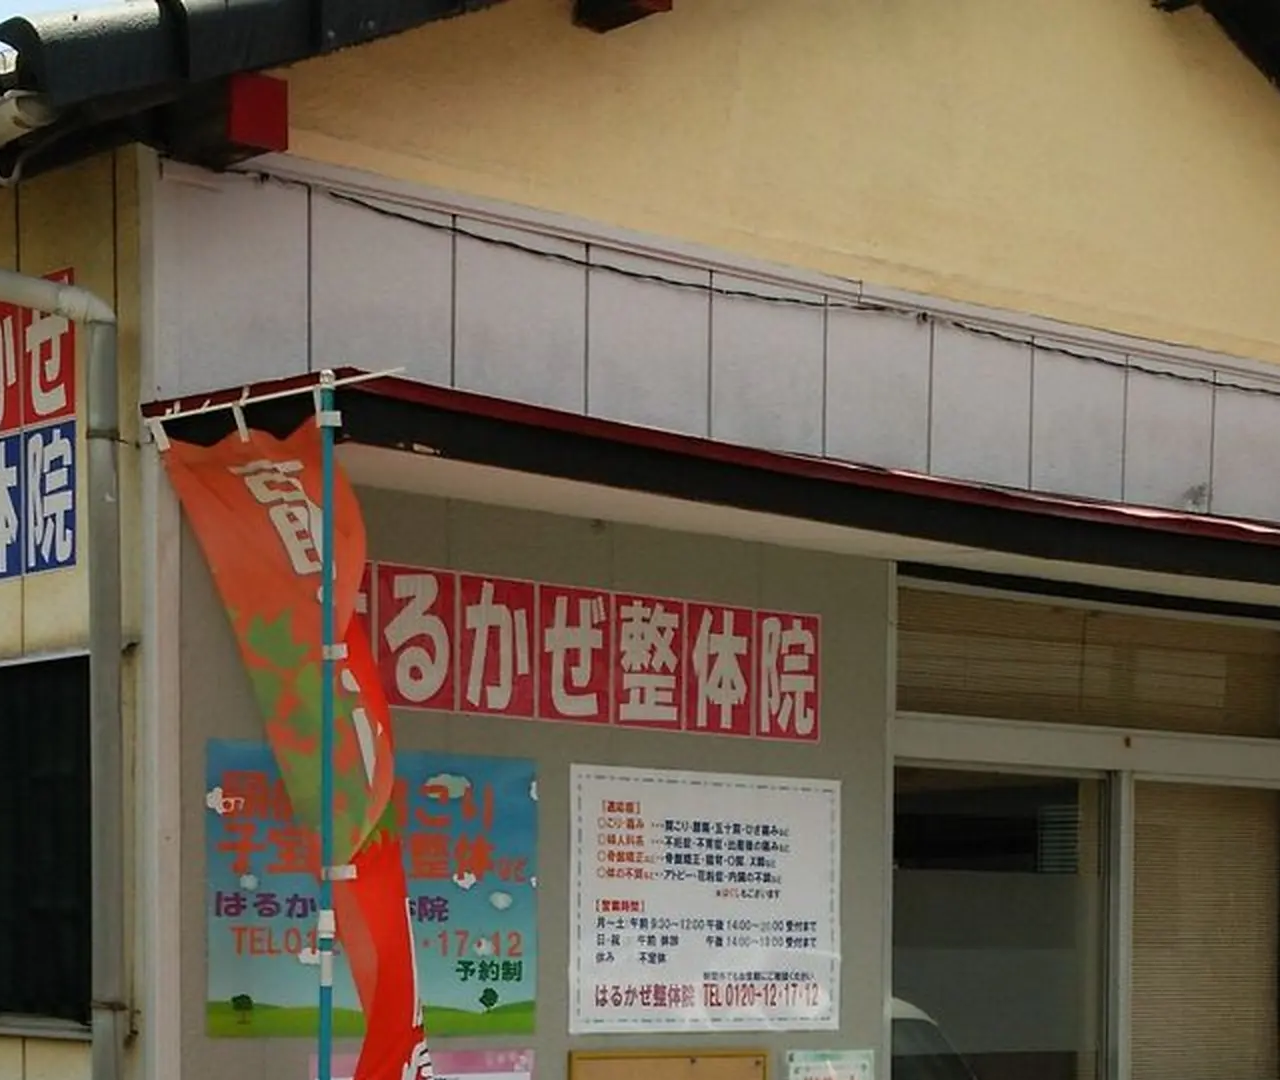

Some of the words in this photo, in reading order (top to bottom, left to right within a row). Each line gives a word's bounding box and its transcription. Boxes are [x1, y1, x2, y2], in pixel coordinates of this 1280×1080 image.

[356, 572, 816, 737] るかぜ整体院
[455, 960, 523, 982] 予約制
[594, 983, 696, 1008] はるかぜ整体院
[702, 983, 721, 1007] TEL
